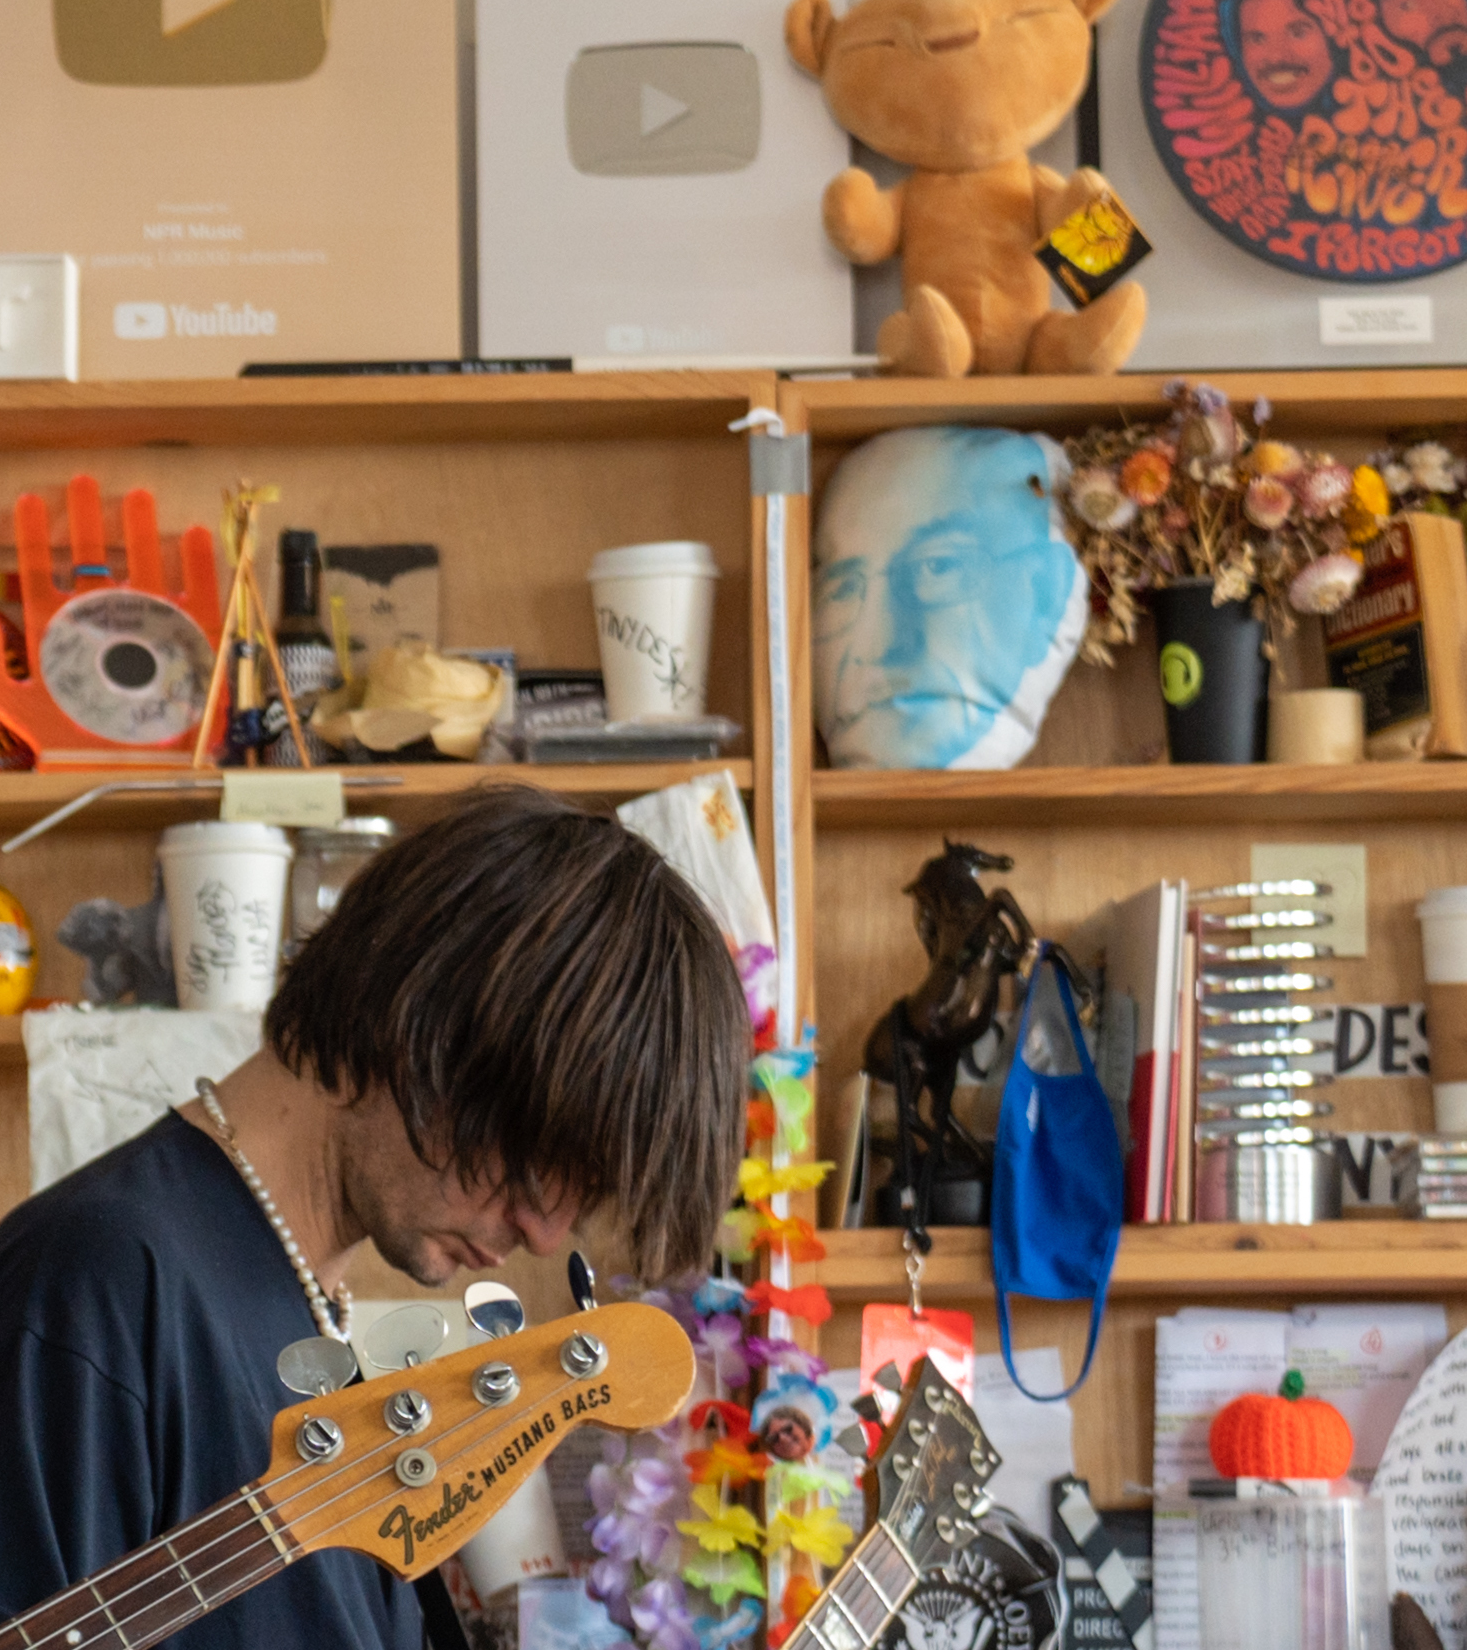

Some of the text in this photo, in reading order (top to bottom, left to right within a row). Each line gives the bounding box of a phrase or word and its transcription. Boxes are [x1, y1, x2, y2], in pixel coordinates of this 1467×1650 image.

[143, 223, 244, 240] NPR Music
[170, 302, 278, 337] YouTube
[378, 1383, 614, 1566] Fender MUSTANG BASS
